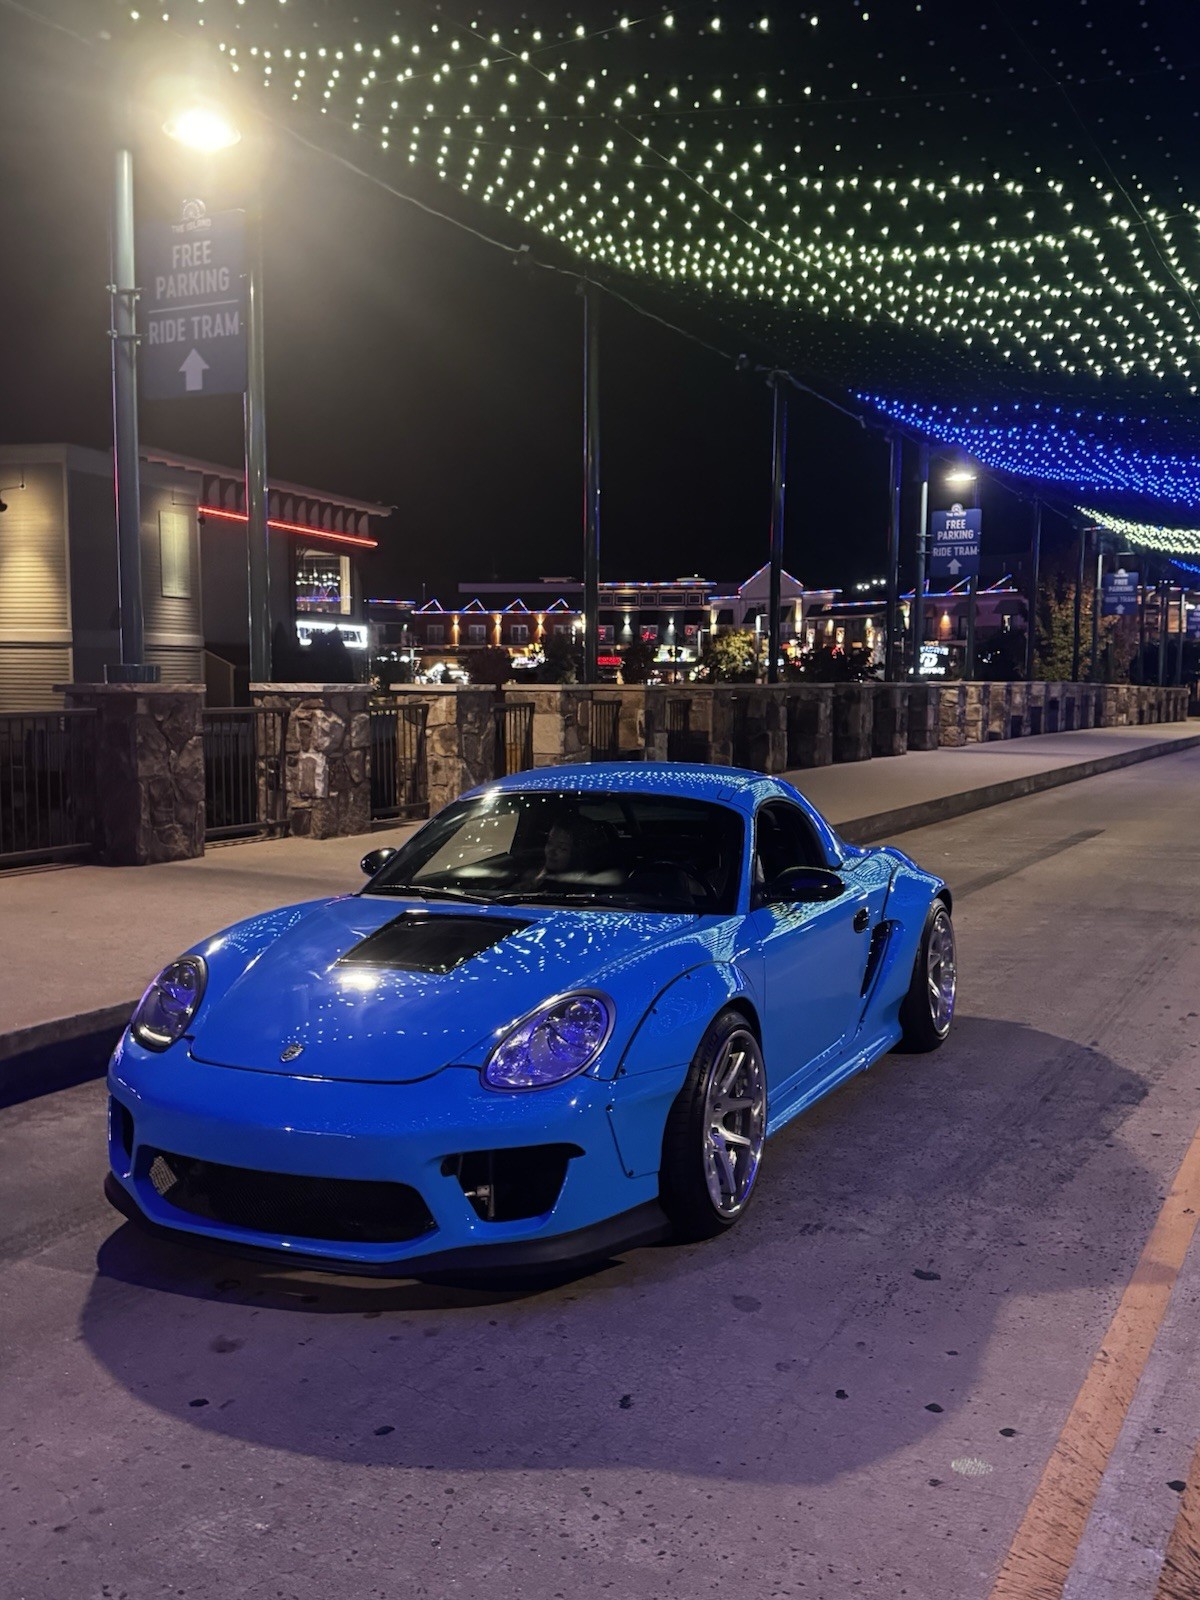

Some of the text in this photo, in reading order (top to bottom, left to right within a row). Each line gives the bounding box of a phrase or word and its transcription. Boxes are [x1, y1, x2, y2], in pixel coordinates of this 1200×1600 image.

[173, 240, 211, 269] FREE
[156, 267, 229, 300] PARKING
[149, 311, 239, 345] RIDE TRAM
[946, 519, 966, 529] FREE
[937, 530, 974, 540] PARKING
[932, 546, 978, 557] RIDE TRAM
